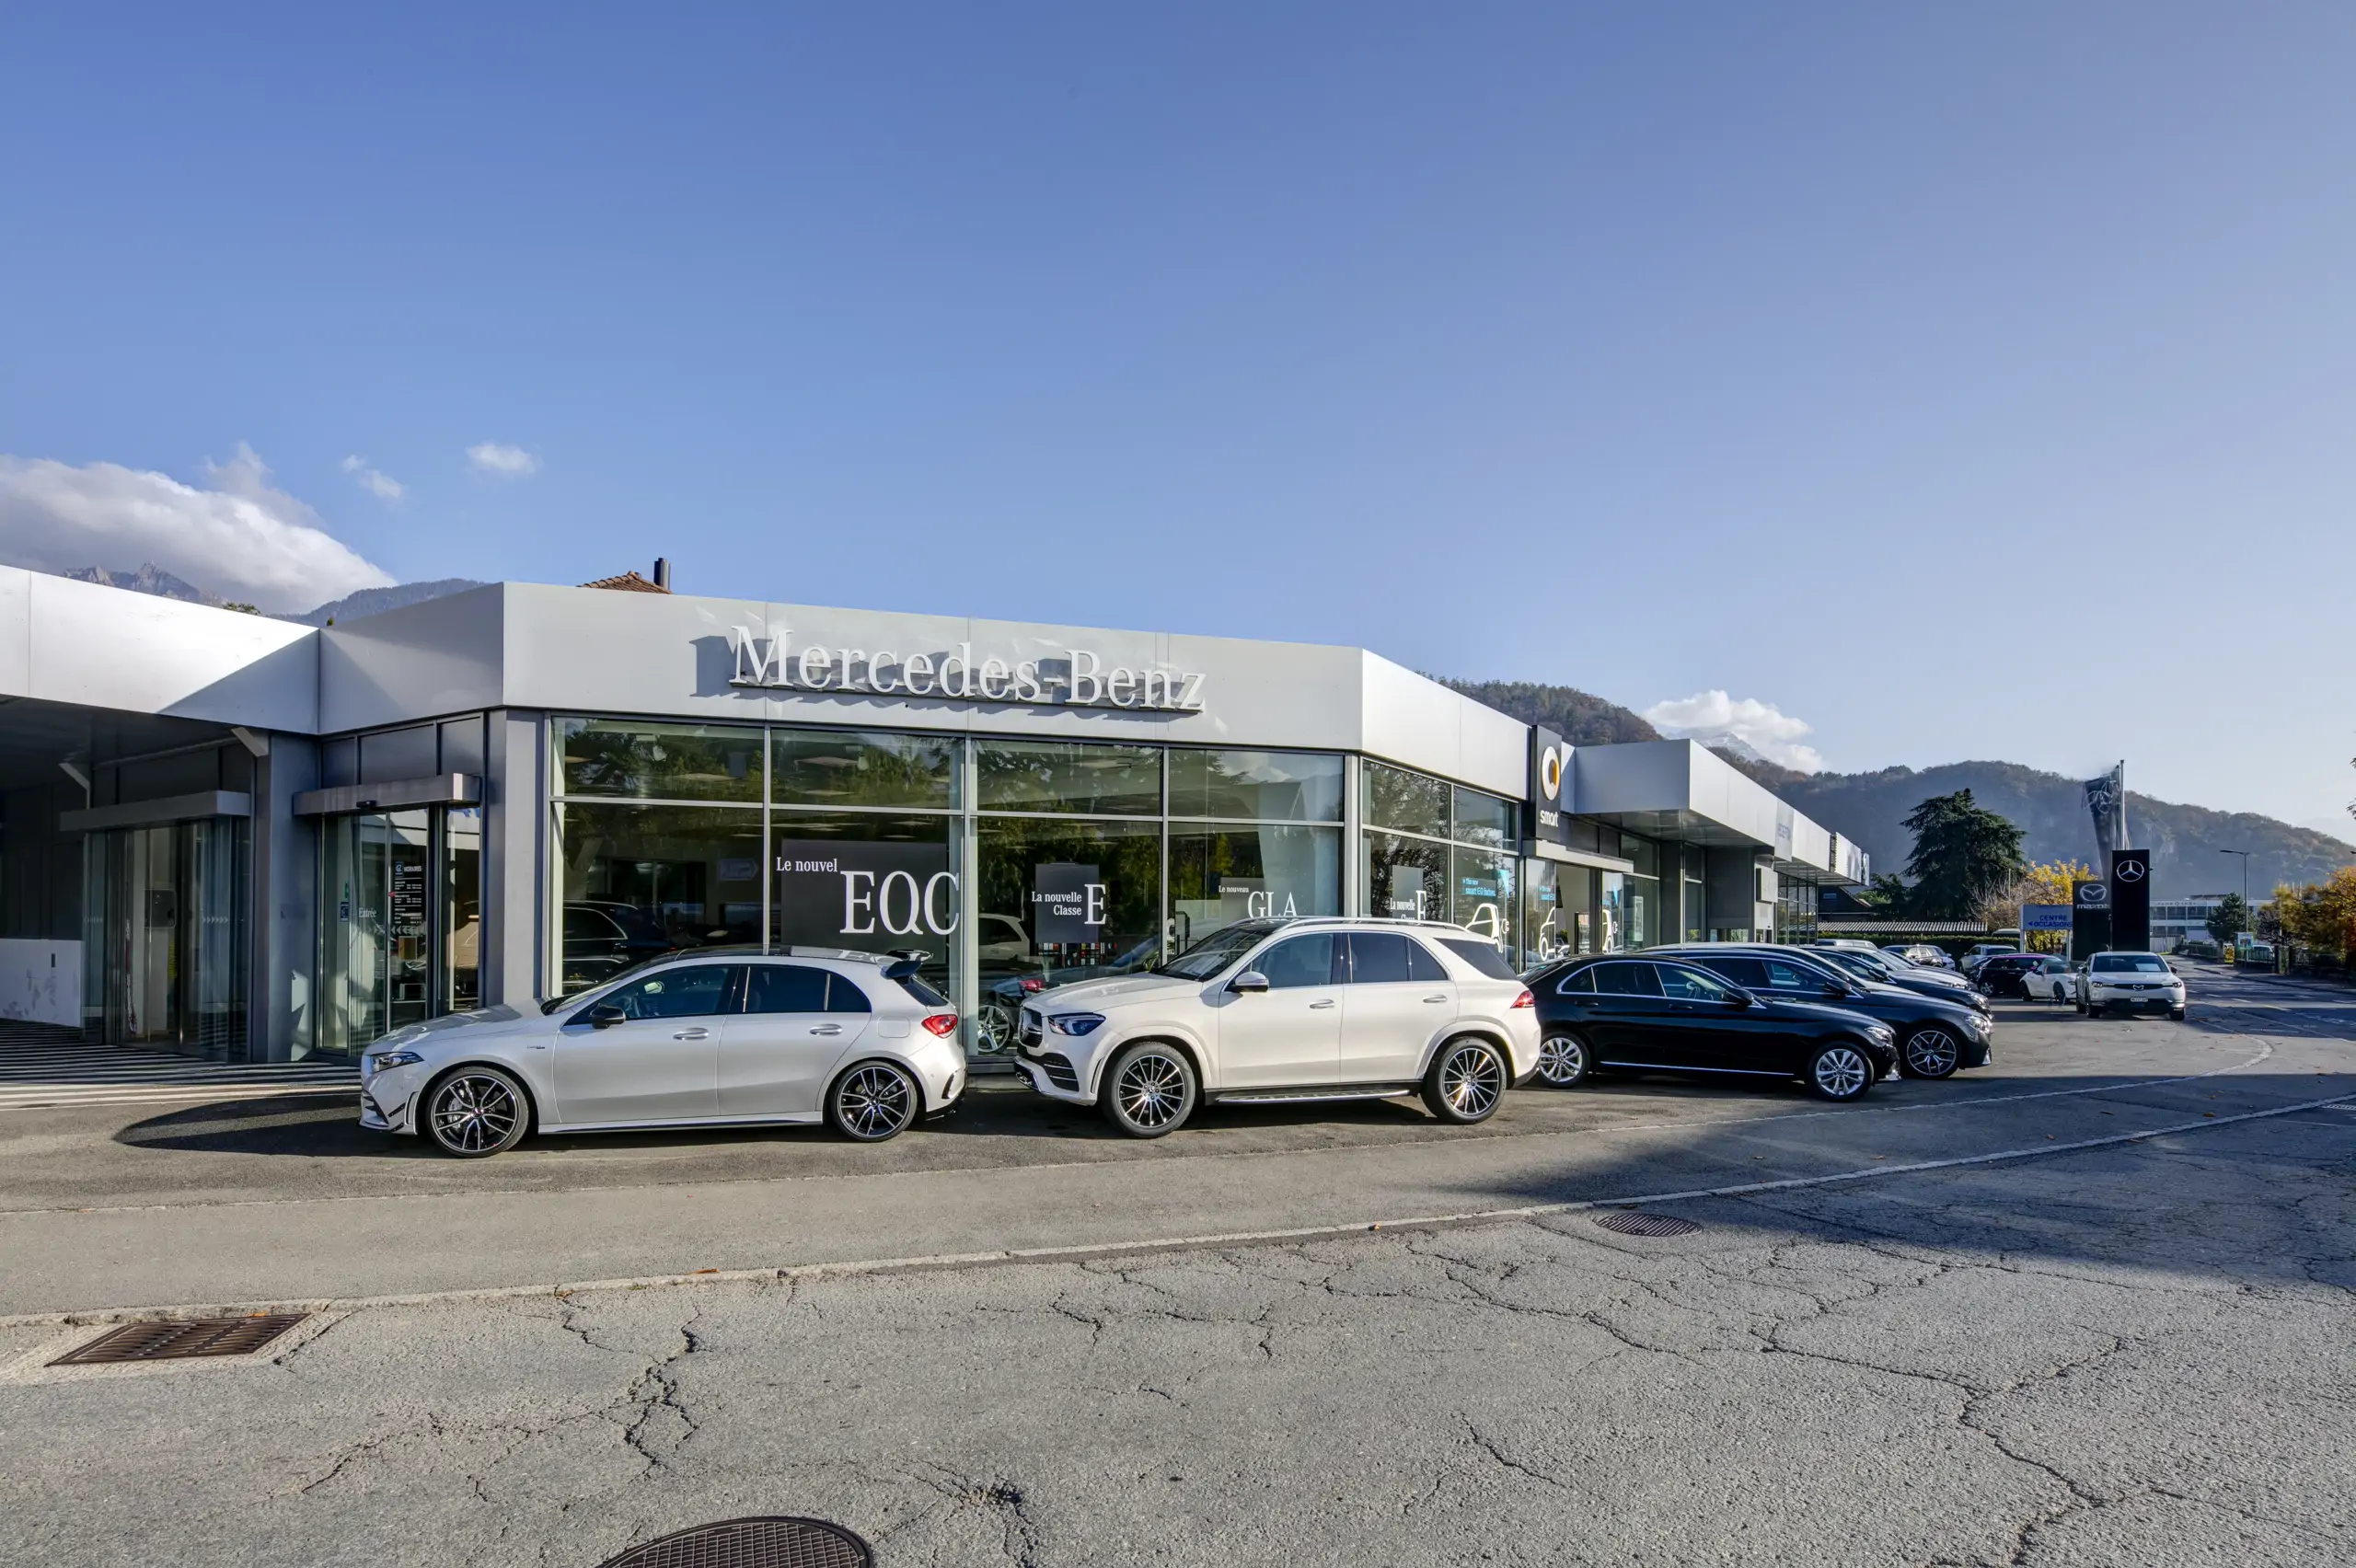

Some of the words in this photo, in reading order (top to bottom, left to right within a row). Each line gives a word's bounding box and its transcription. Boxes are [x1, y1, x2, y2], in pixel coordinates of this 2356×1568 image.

[728, 625, 1207, 713] Mercedes-Benz
[1540, 810, 1559, 827] smart
[776, 857, 791, 871] Le
[795, 858, 838, 872] nouvel
[839, 870, 960, 935] EQC
[1031, 891, 1043, 903] La
[1045, 891, 1082, 903] nouvelle
[1084, 883, 1107, 925] E
[1247, 891, 1298, 918] GLA
[1390, 897, 1396, 910] La
[1396, 898, 1415, 911] nouvelle
[1415, 890, 1427, 920] E
[1053, 904, 1082, 916] Classe
